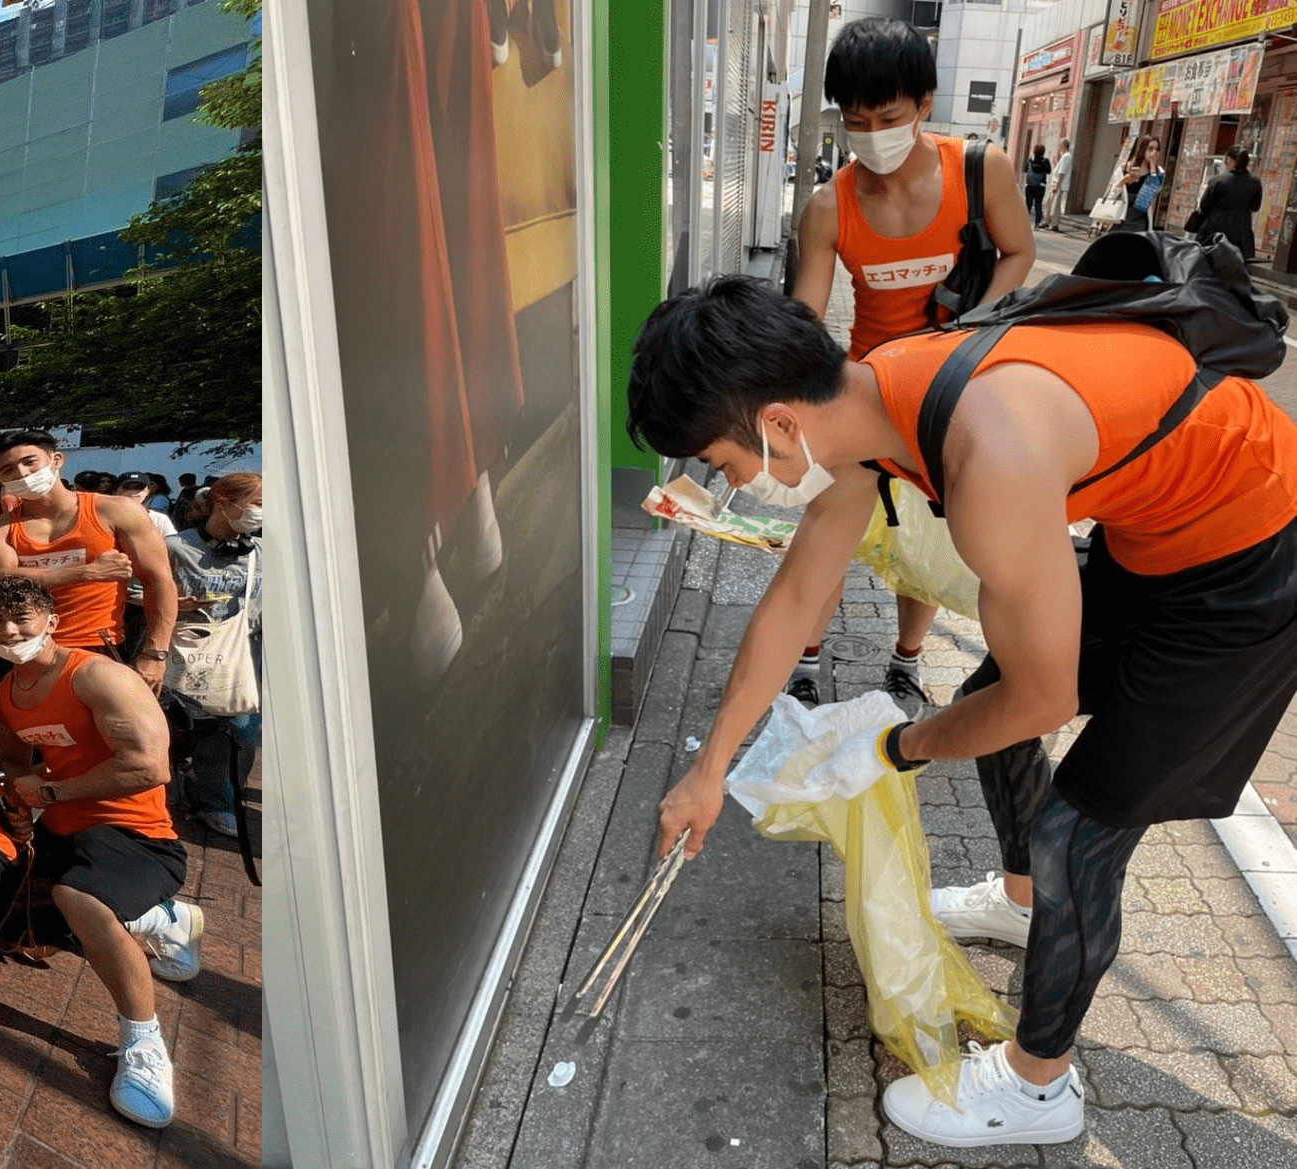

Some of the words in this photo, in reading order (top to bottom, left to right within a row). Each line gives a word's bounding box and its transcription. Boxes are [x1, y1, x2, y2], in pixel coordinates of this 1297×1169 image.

[760, 100, 777, 152] KIRIN
[866, 263, 948, 282] エコマッチョ
